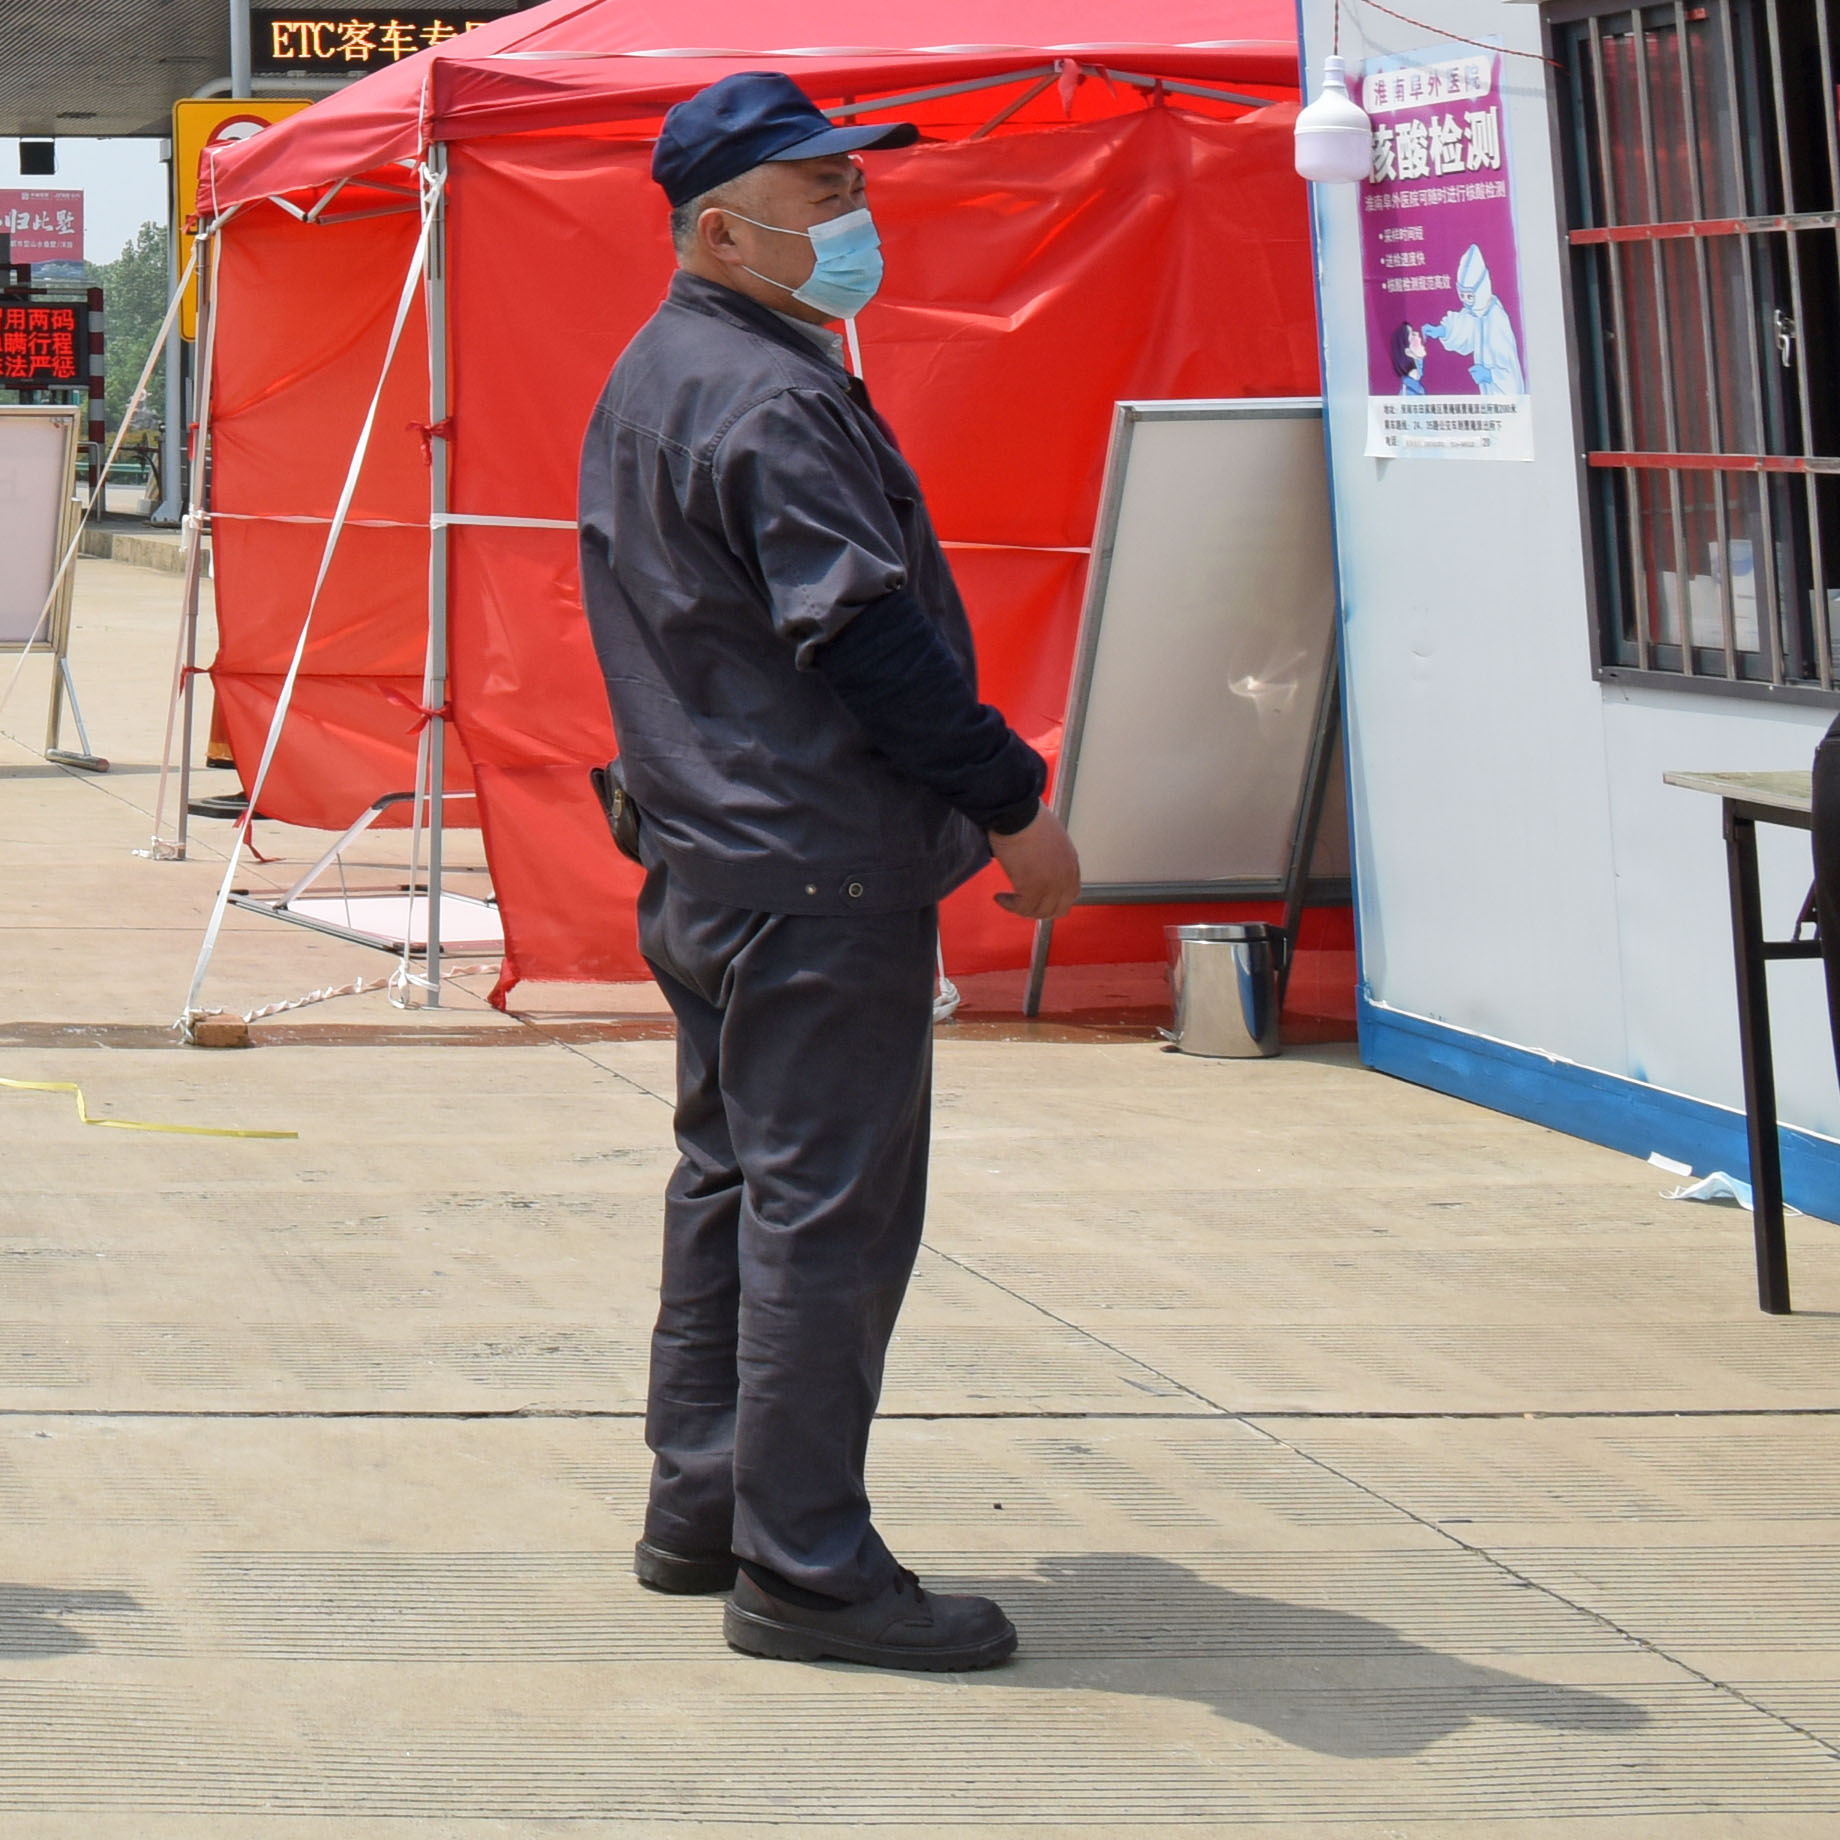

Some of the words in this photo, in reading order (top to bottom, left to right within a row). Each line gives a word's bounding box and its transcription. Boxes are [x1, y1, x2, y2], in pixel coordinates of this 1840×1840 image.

[1373, 64, 1482, 106] 淮南阜外医院
[1368, 105, 1501, 184] 核酸检测
